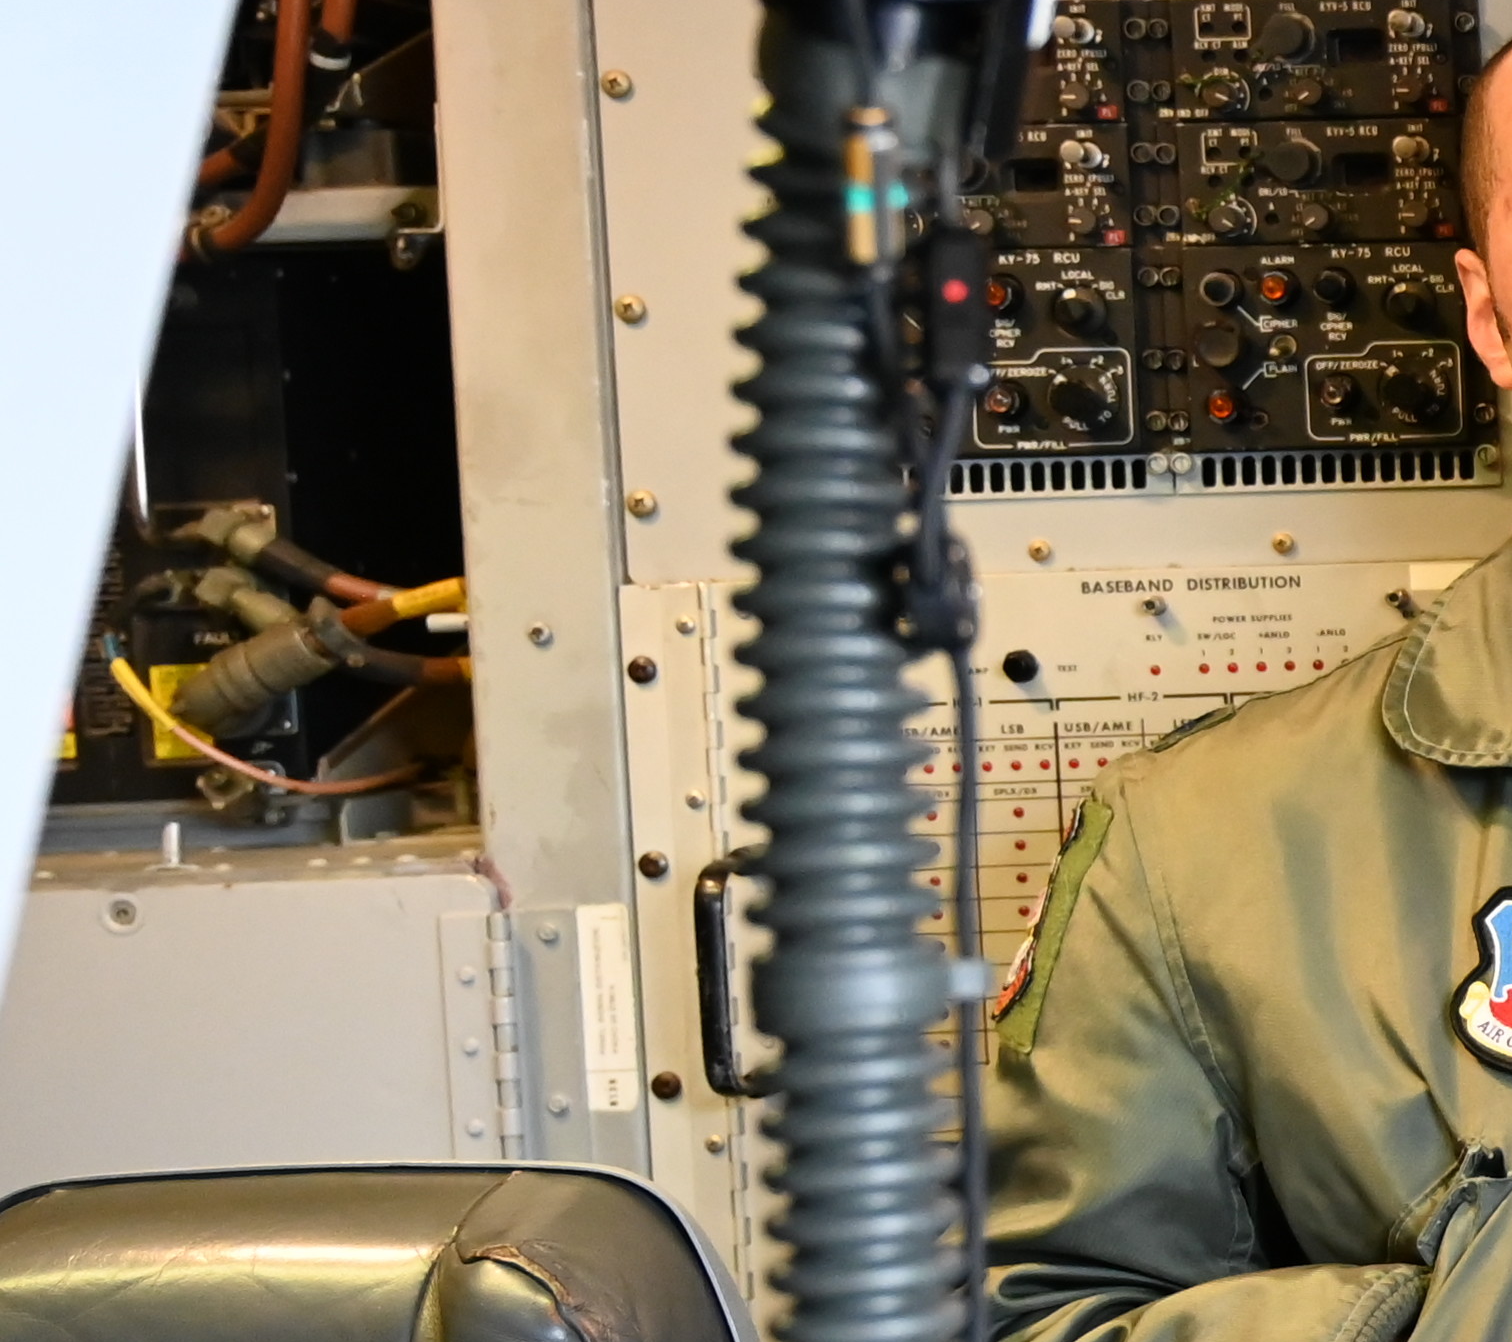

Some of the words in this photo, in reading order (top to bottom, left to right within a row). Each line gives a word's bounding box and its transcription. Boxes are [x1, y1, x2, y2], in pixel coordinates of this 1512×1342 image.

[998, 252, 1041, 265] KY-75
[1053, 252, 1080, 264] RCU
[1331, 248, 1372, 259] KY-75
[1385, 247, 1411, 257] RCU
[1260, 256, 1295, 265] ALARM
[1392, 264, 1424, 273] LOCAL
[1061, 270, 1095, 280] LOCAL
[1368, 275, 1388, 284] RMT
[1435, 284, 1455, 293] CLR
[1105, 291, 1126, 300] CLR
[1263, 319, 1298, 329] CIPHER
[1268, 364, 1298, 373] PLAIN
[1315, 360, 1380, 371] OFF/ZEROIZE
[1081, 578, 1174, 595] BASEBAND
[1187, 575, 1302, 591] DISTRIBUTION
[1212, 615, 1247, 624] POWER
[1251, 613, 1293, 622] SUPPLIES
[1127, 691, 1160, 703] HF-2
[902, 726, 958, 738] SB/AME
[1000, 723, 1026, 735] LSB
[1063, 720, 1134, 734] USB/AME
[1477, 1020, 1505, 1043] AIR
